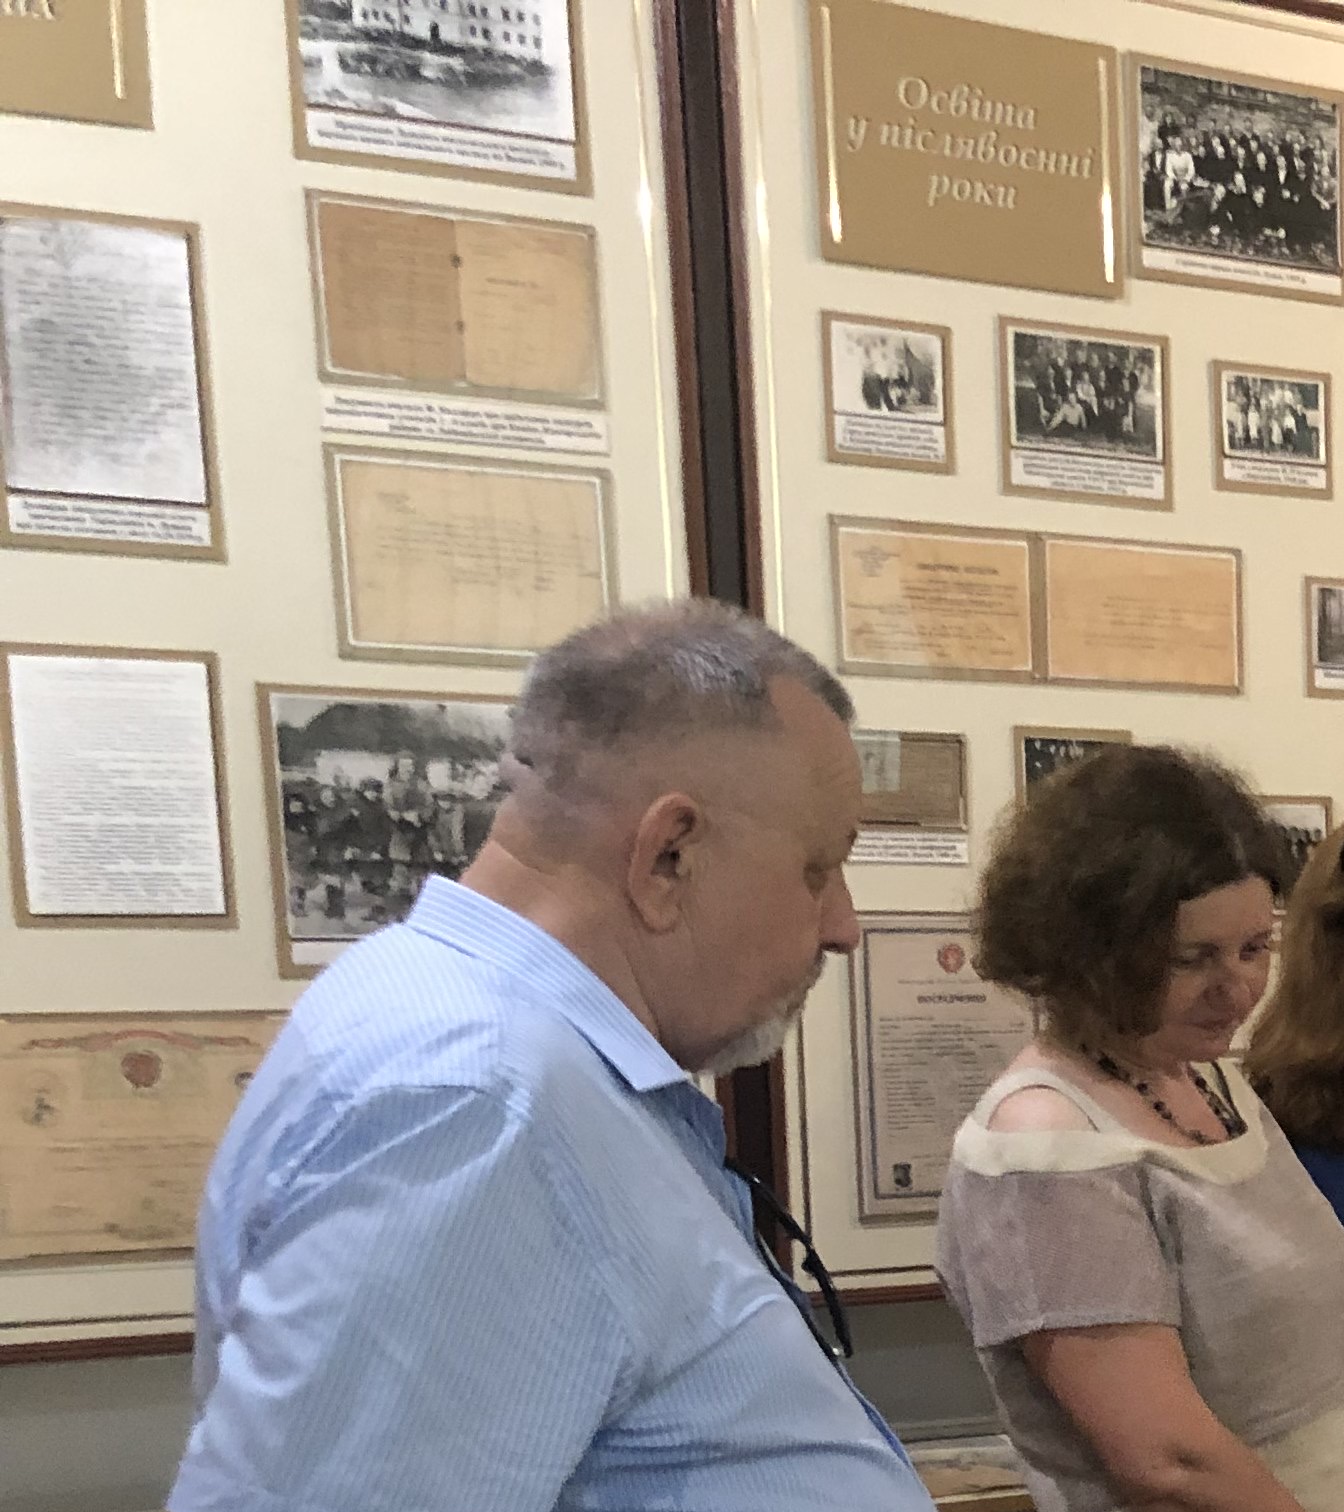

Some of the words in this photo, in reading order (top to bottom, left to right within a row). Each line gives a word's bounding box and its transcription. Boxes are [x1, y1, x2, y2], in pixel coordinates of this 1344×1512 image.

[897, 76, 1036, 131] Освіта
[847, 115, 868, 152] у
[927, 173, 1016, 210] роки
